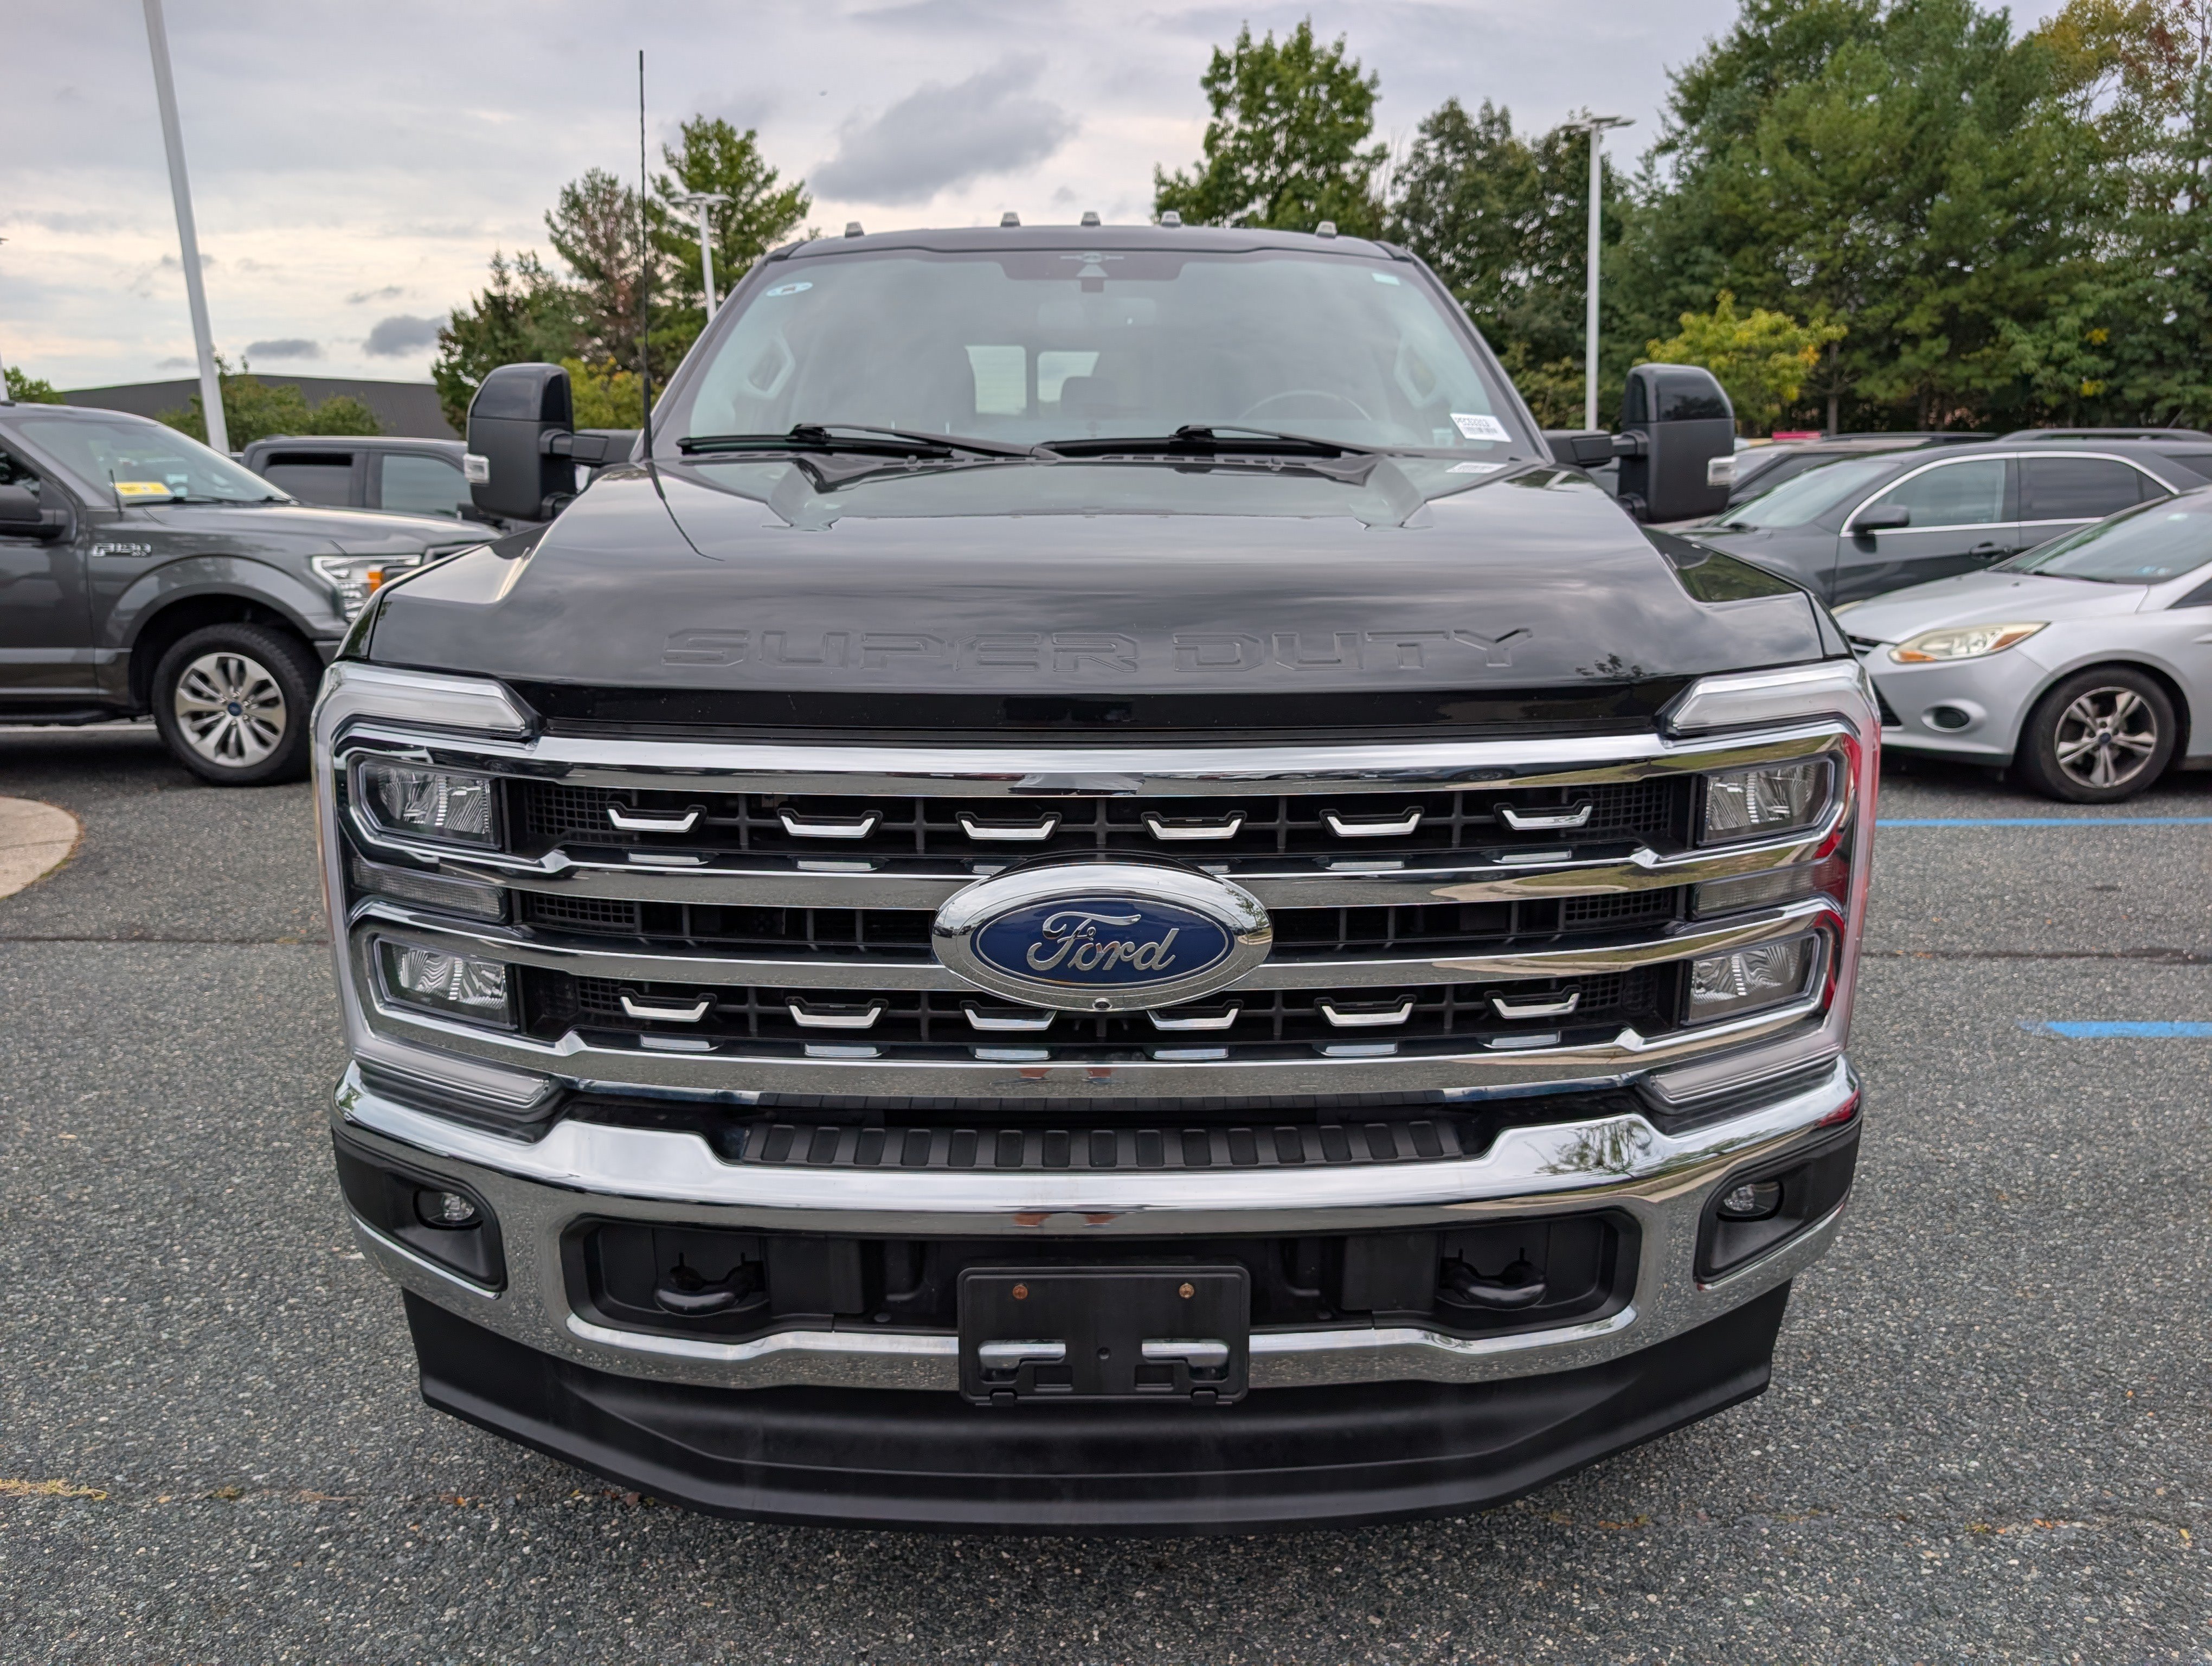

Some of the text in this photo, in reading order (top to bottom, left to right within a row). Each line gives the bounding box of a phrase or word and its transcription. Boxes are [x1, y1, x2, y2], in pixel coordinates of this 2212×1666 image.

[661, 627, 1533, 673] SUPER DUTY
[1026, 911, 1180, 971] Ford
